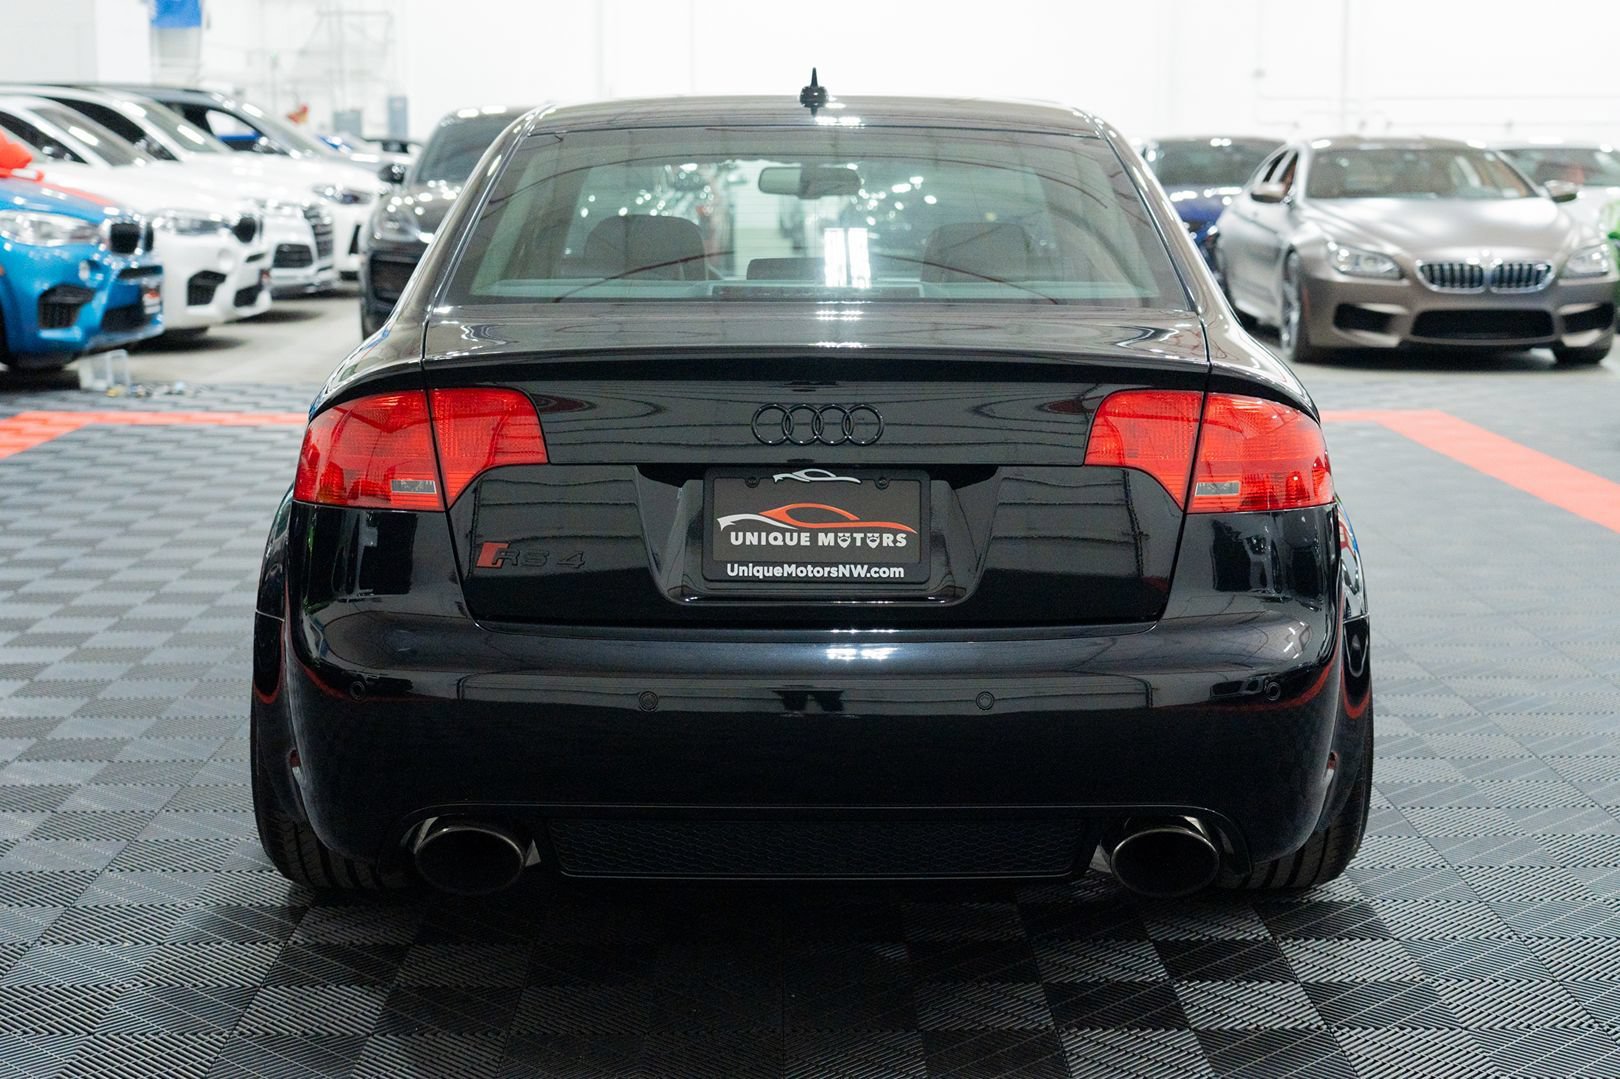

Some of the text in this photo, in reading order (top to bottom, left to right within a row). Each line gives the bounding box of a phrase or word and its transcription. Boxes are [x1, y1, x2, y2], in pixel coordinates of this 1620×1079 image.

[730, 531, 907, 549] UNIQUE MOTORS
[726, 563, 905, 579] UniqueMotorsNW.com
